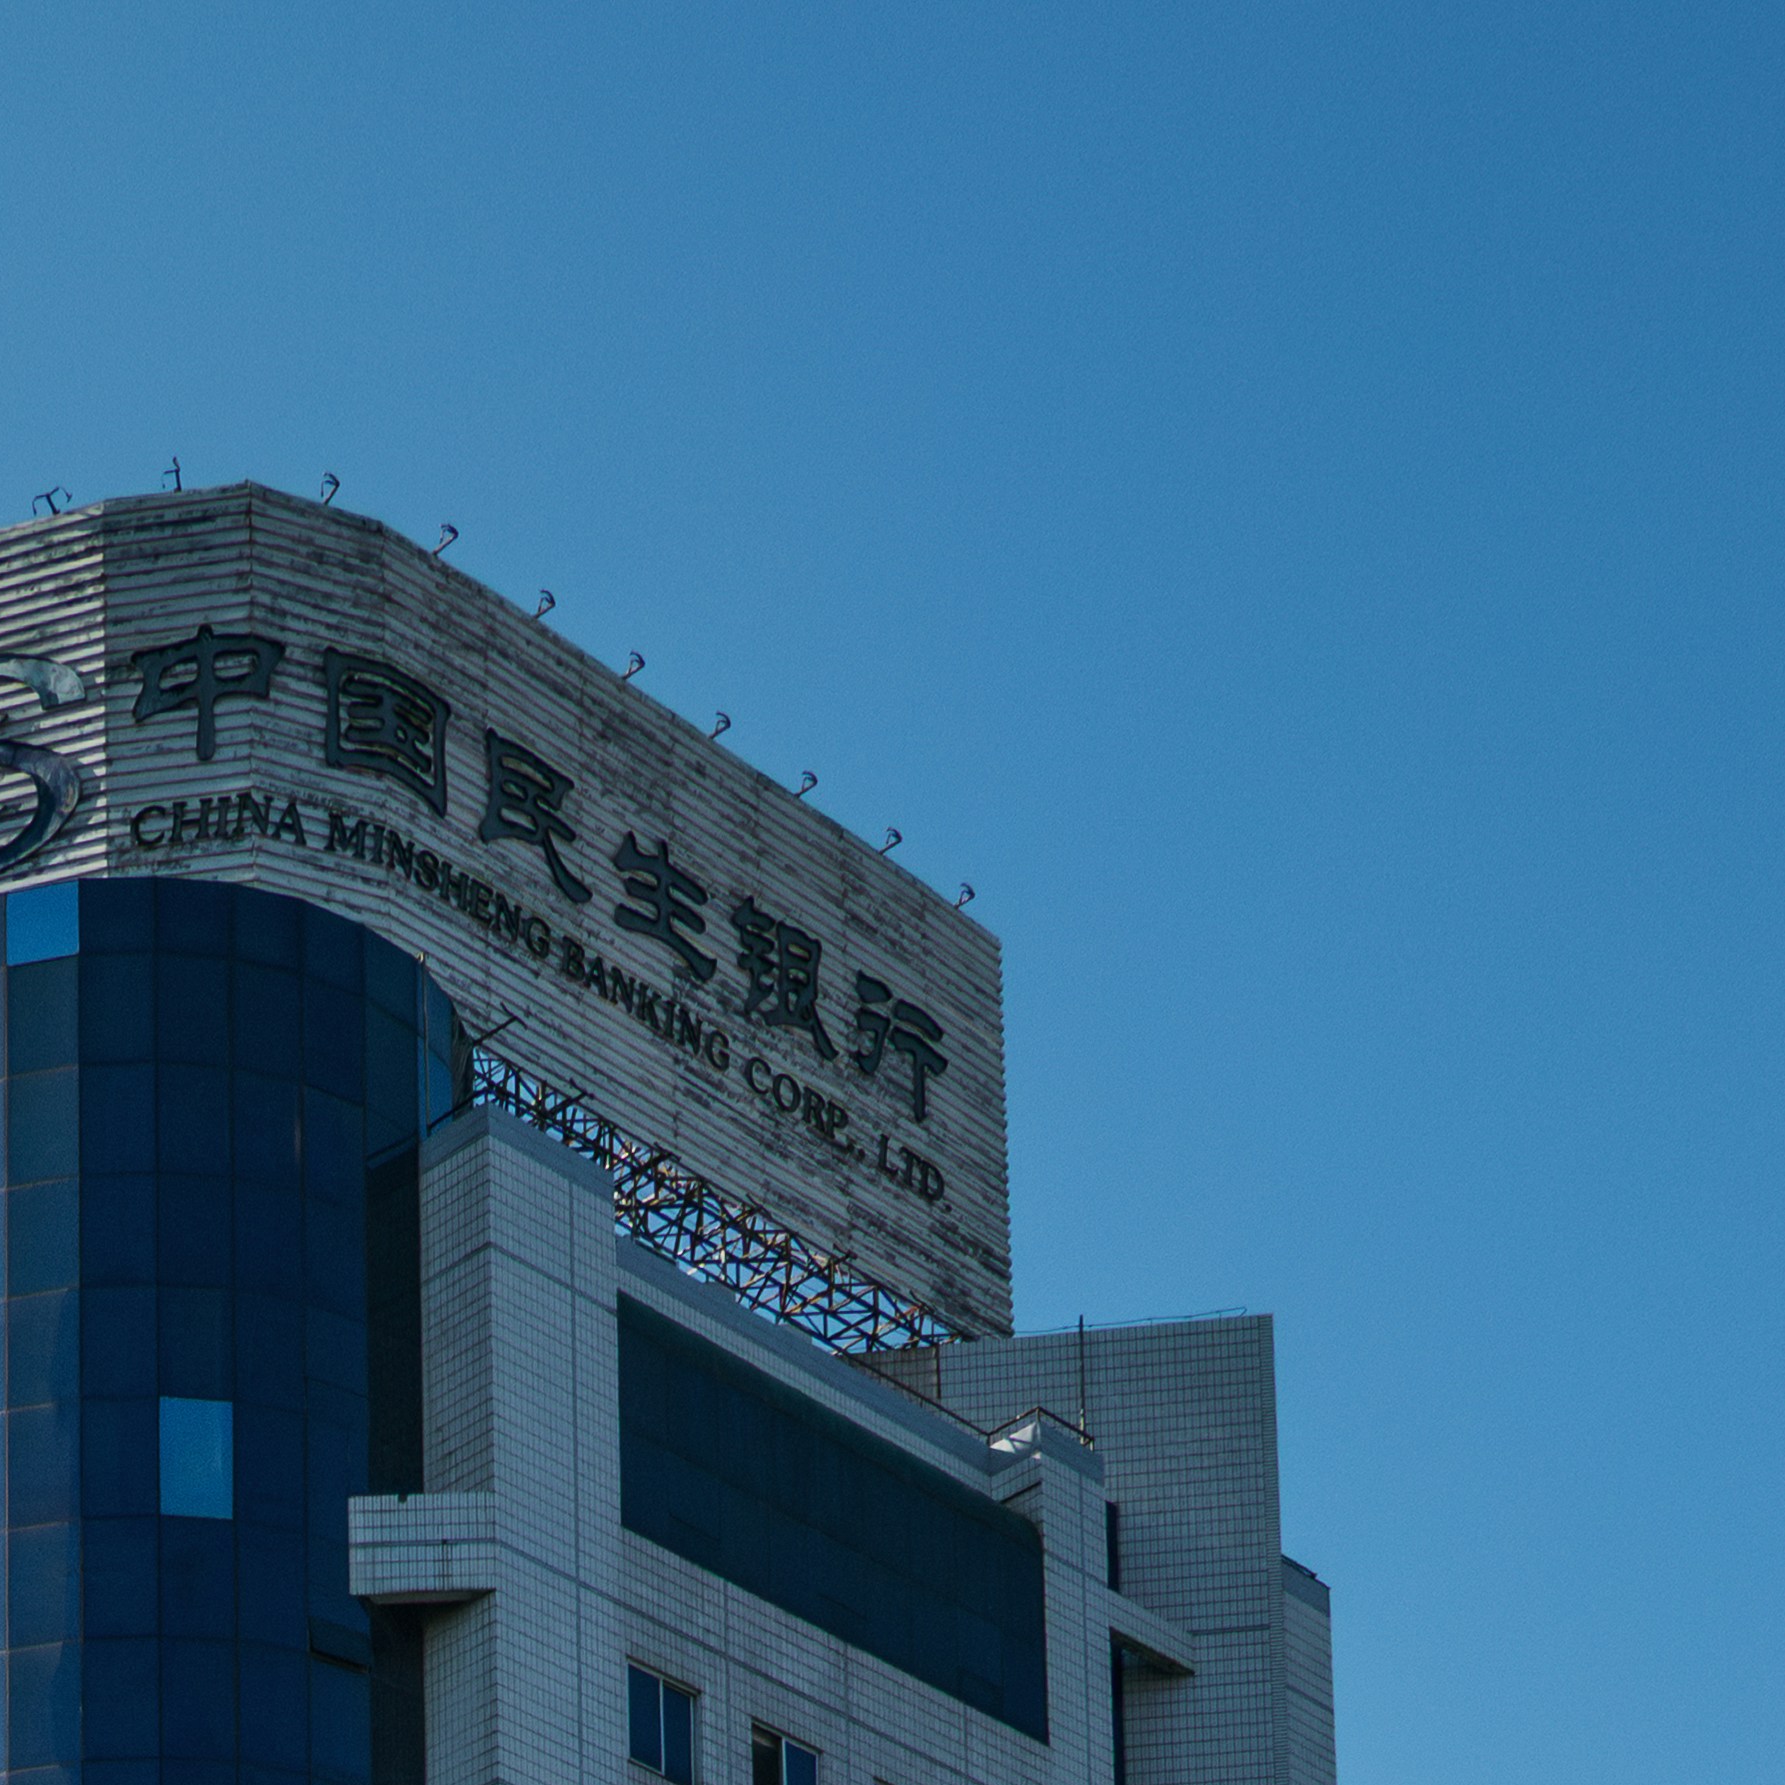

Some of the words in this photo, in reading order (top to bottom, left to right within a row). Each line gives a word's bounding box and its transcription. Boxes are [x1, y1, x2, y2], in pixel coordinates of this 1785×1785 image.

[130, 791, 307, 848] CHINA
[323, 811, 552, 960] MINSHENG
[562, 936, 731, 1071] BANKING
[877, 1134, 953, 1214] LTD.
[131, 625, 949, 1124] 中国民生银行
